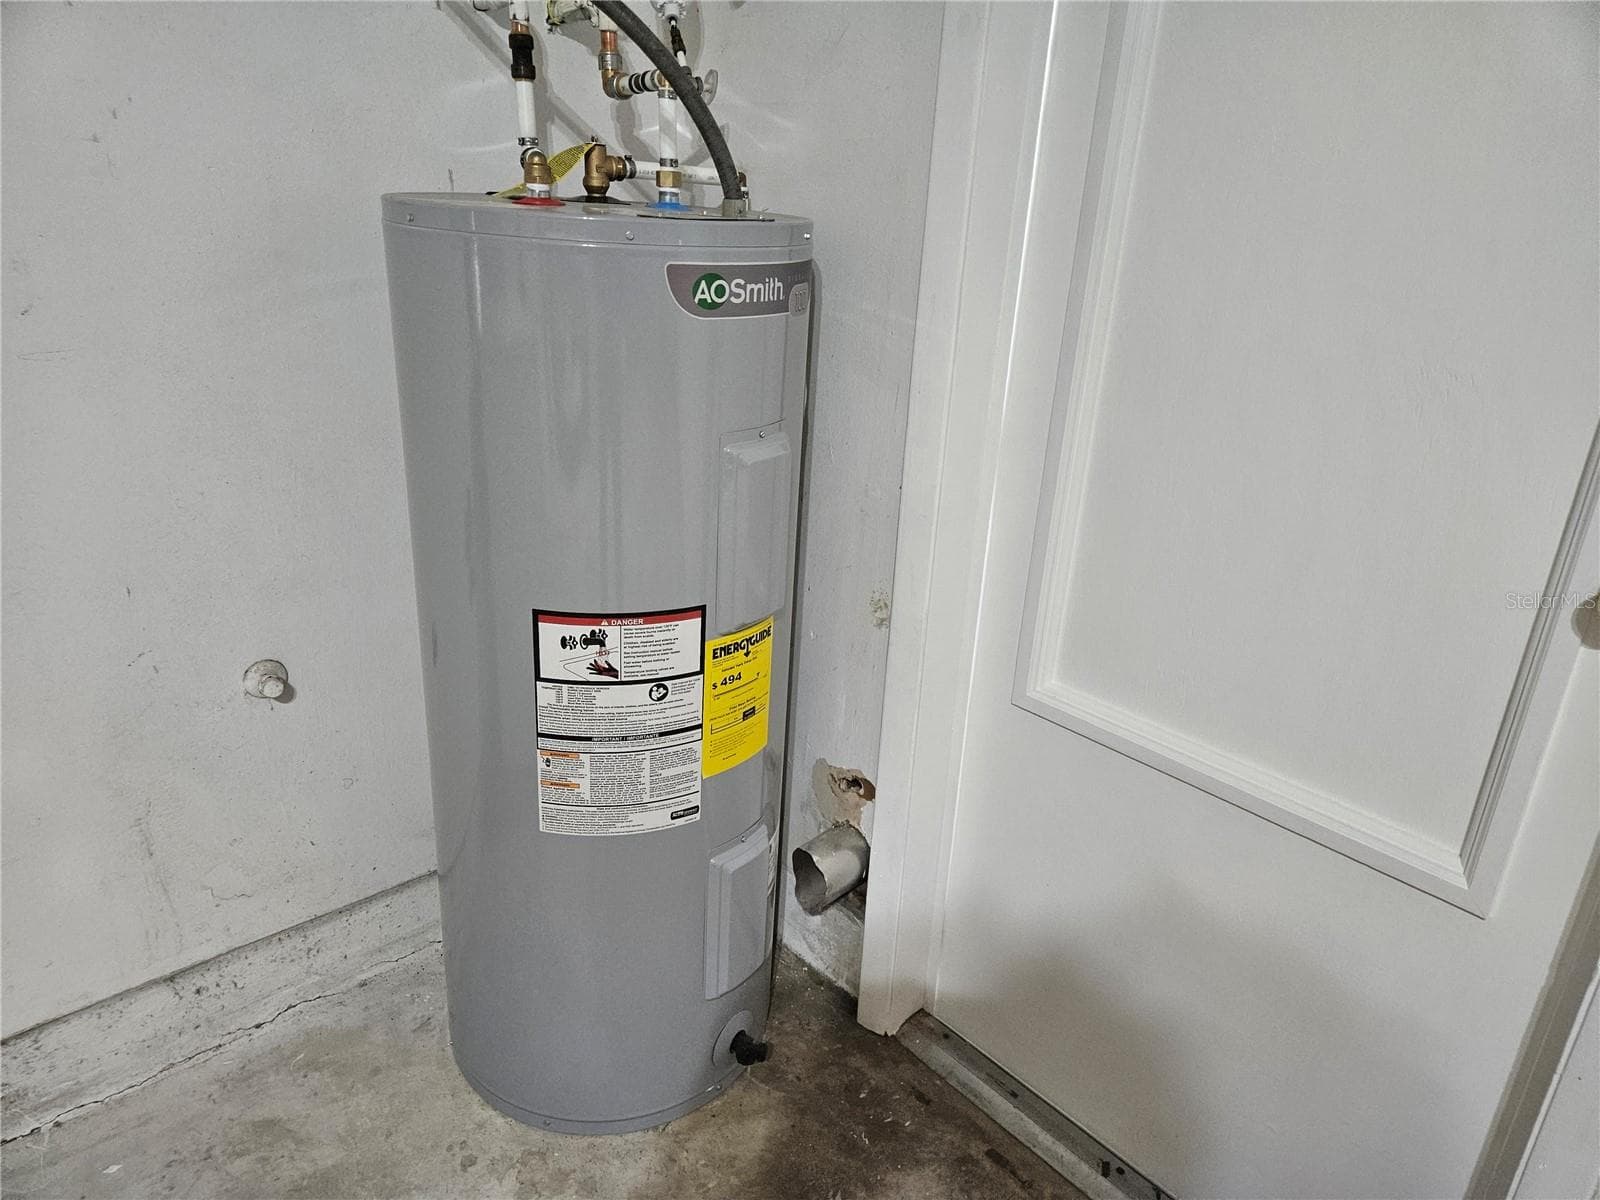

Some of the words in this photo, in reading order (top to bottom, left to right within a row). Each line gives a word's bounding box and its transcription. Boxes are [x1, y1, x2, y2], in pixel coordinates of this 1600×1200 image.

[694, 277, 783, 304] AOSmith
[611, 618, 644, 626] DANGER
[712, 625, 772, 660] ENERGYGUIDE
[720, 672, 742, 687] 494
